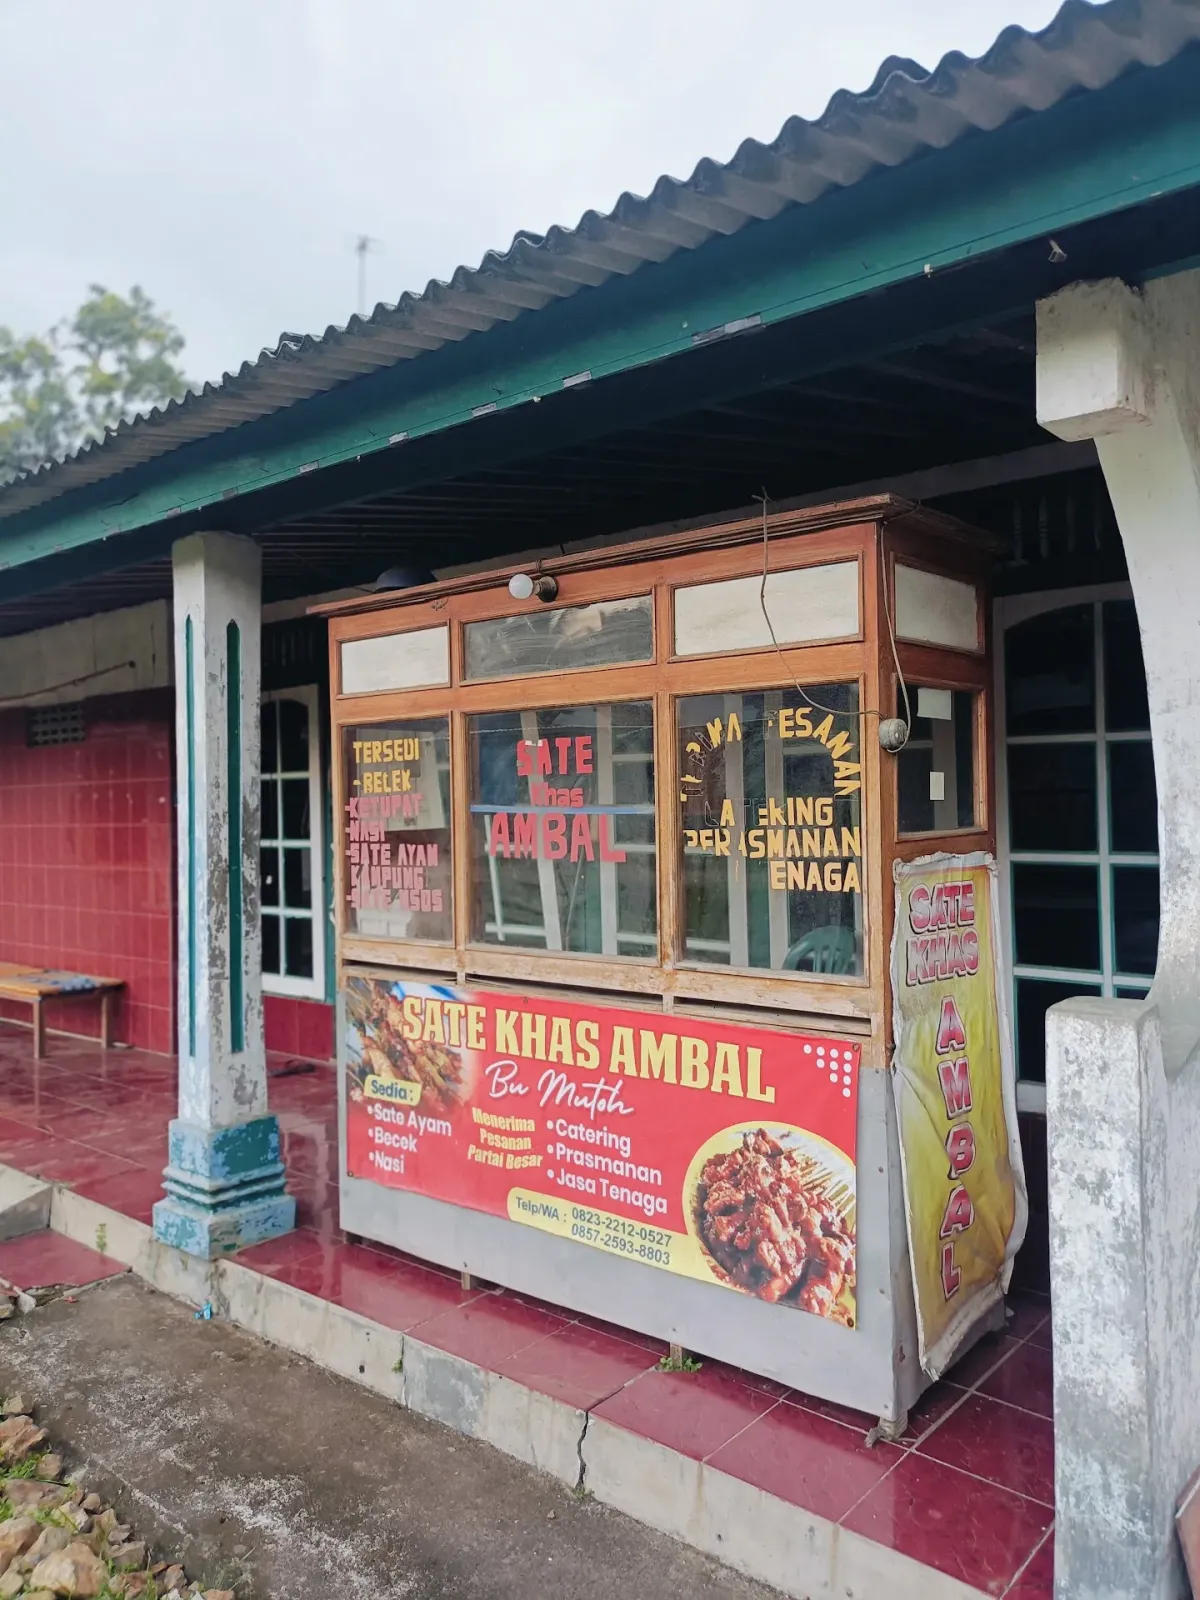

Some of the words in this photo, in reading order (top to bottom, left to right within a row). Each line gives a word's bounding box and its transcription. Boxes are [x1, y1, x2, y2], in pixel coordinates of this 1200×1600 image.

[516, 736, 593, 776] SATE
[489, 812, 627, 863] AMBAL
[909, 882, 975, 934] SATE
[907, 928, 979, 986] KHAS
[403, 995, 486, 1050] SATE
[495, 1008, 600, 1070] KHAS
[608, 1025, 776, 1104] AMBAL
[485, 1060, 529, 1098] Bu
[374, 1103, 404, 1126] Sate
[407, 1110, 452, 1137] Ayam
[472, 1107, 536, 1132] Menerima
[480, 1128, 532, 1151] Pesanan
[555, 1118, 632, 1157] Catering
[374, 1127, 417, 1153] Becek
[467, 1144, 504, 1168] Partai
[506, 1153, 543, 1170] Besar
[374, 1150, 405, 1174] Nasi
[555, 1144, 662, 1187] Prasmanan
[556, 1169, 596, 1194] Jasa
[599, 1178, 668, 1216] Tenaga
[571, 1223, 670, 1265] 0857-2593-8803
[572, 1207, 672, 1247] 0823-2212-0527
